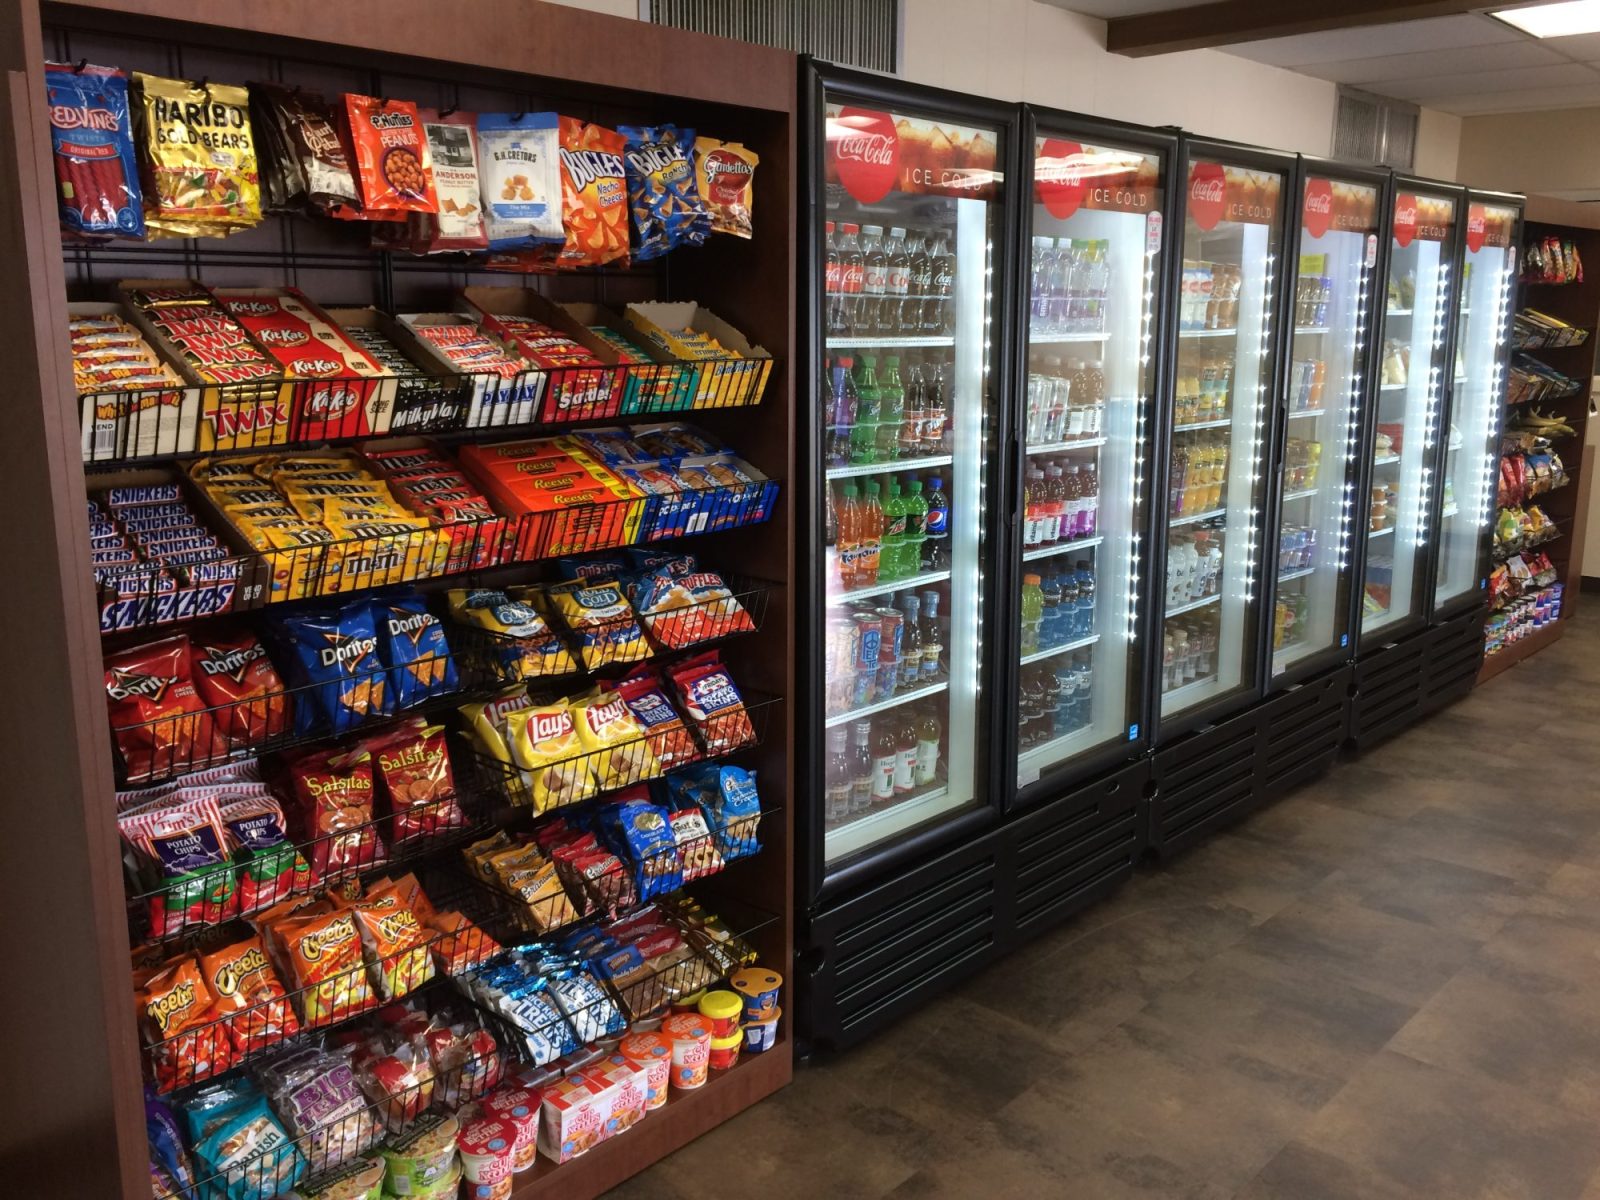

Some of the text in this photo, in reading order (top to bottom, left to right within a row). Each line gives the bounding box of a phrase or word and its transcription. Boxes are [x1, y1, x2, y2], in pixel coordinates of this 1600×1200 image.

[154, 96, 244, 129] HARIBO
[380, 132, 419, 149] PEANUTS
[836, 134, 895, 165] Coca-Cola
[560, 147, 625, 192] BUGLES
[627, 142, 688, 177] BUGLE
[435, 170, 476, 180] ANDERSON
[906, 168, 982, 191] ICE COLD
[597, 180, 619, 193] Nacho
[1191, 178, 1224, 203] Coca-Cola
[599, 193, 624, 208] Cheese
[1090, 188, 1147, 207] ICE COLD
[1305, 193, 1331, 214] Coca-Cola
[1228, 203, 1272, 219] ICE COLD
[153, 314, 238, 336] TWIX
[170, 328, 250, 350] TWIX
[201, 363, 281, 384] TWIX
[203, 403, 288, 440] TWIX
[392, 405, 434, 429] Milky
[111, 486, 178, 504] SNICKERS
[119, 504, 187, 521] SNICKERS
[127, 514, 194, 533] SNICKERS
[139, 527, 206, 545] SNICKERS
[150, 536, 216, 557] SNICKERS
[161, 548, 228, 566] SNICKERS
[580, 591, 617, 609] GOLD
[200, 643, 266, 675] Doritos
[592, 698, 625, 732] Lay's
[532, 712, 572, 745] Lay's
[379, 748, 444, 772] Salsitas
[307, 776, 372, 797] Salsitas
[157, 815, 195, 833] Tim's
[239, 819, 268, 832] POTATO
[166, 836, 201, 849] POTATO
[175, 845, 201, 856] CHIPS
[301, 916, 355, 961] Cheetos
[216, 949, 267, 997] Cheeto
[298, 1064, 353, 1110] BIG
